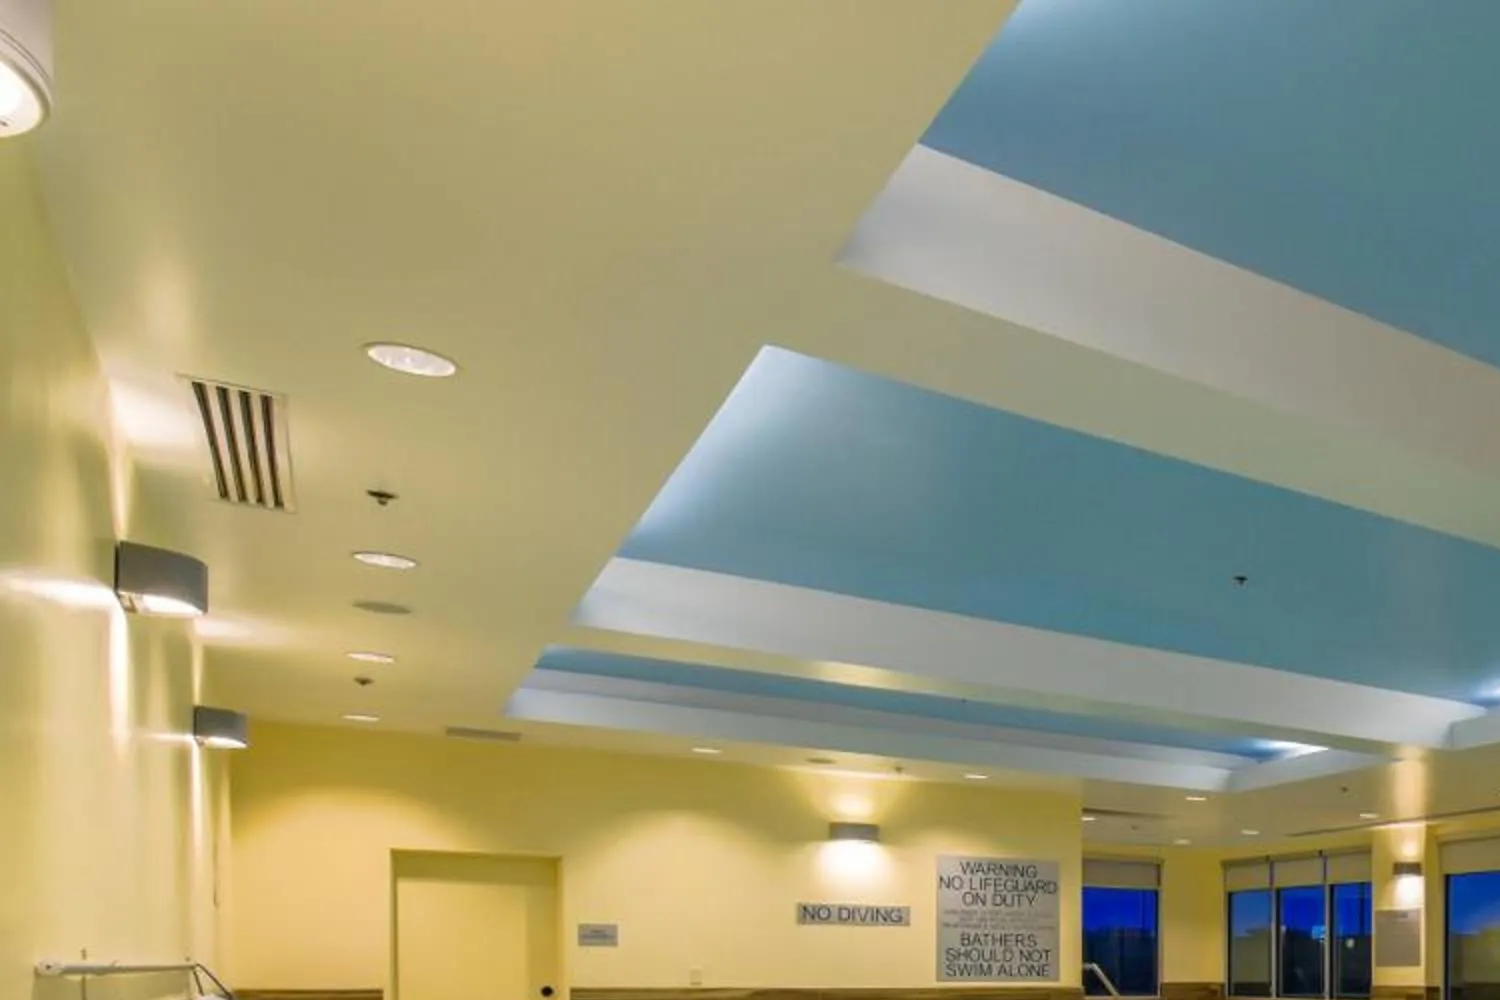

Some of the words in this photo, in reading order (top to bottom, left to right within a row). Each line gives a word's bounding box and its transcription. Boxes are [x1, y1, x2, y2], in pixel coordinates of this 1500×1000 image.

[960, 861, 1038, 879] WARNING
[939, 875, 964, 890] NO
[969, 877, 1058, 895] LIFEGUARD
[962, 891, 987, 907] ON
[992, 893, 1037, 908] DUTY
[802, 905, 831, 921] NO
[838, 907, 903, 923] DIVING
[960, 932, 1038, 949] BATHERS
[944, 947, 1014, 963] SHOULD
[1019, 949, 1052, 963] NOT
[945, 963, 993, 977] SWIM
[998, 963, 1051, 978] ALONE
